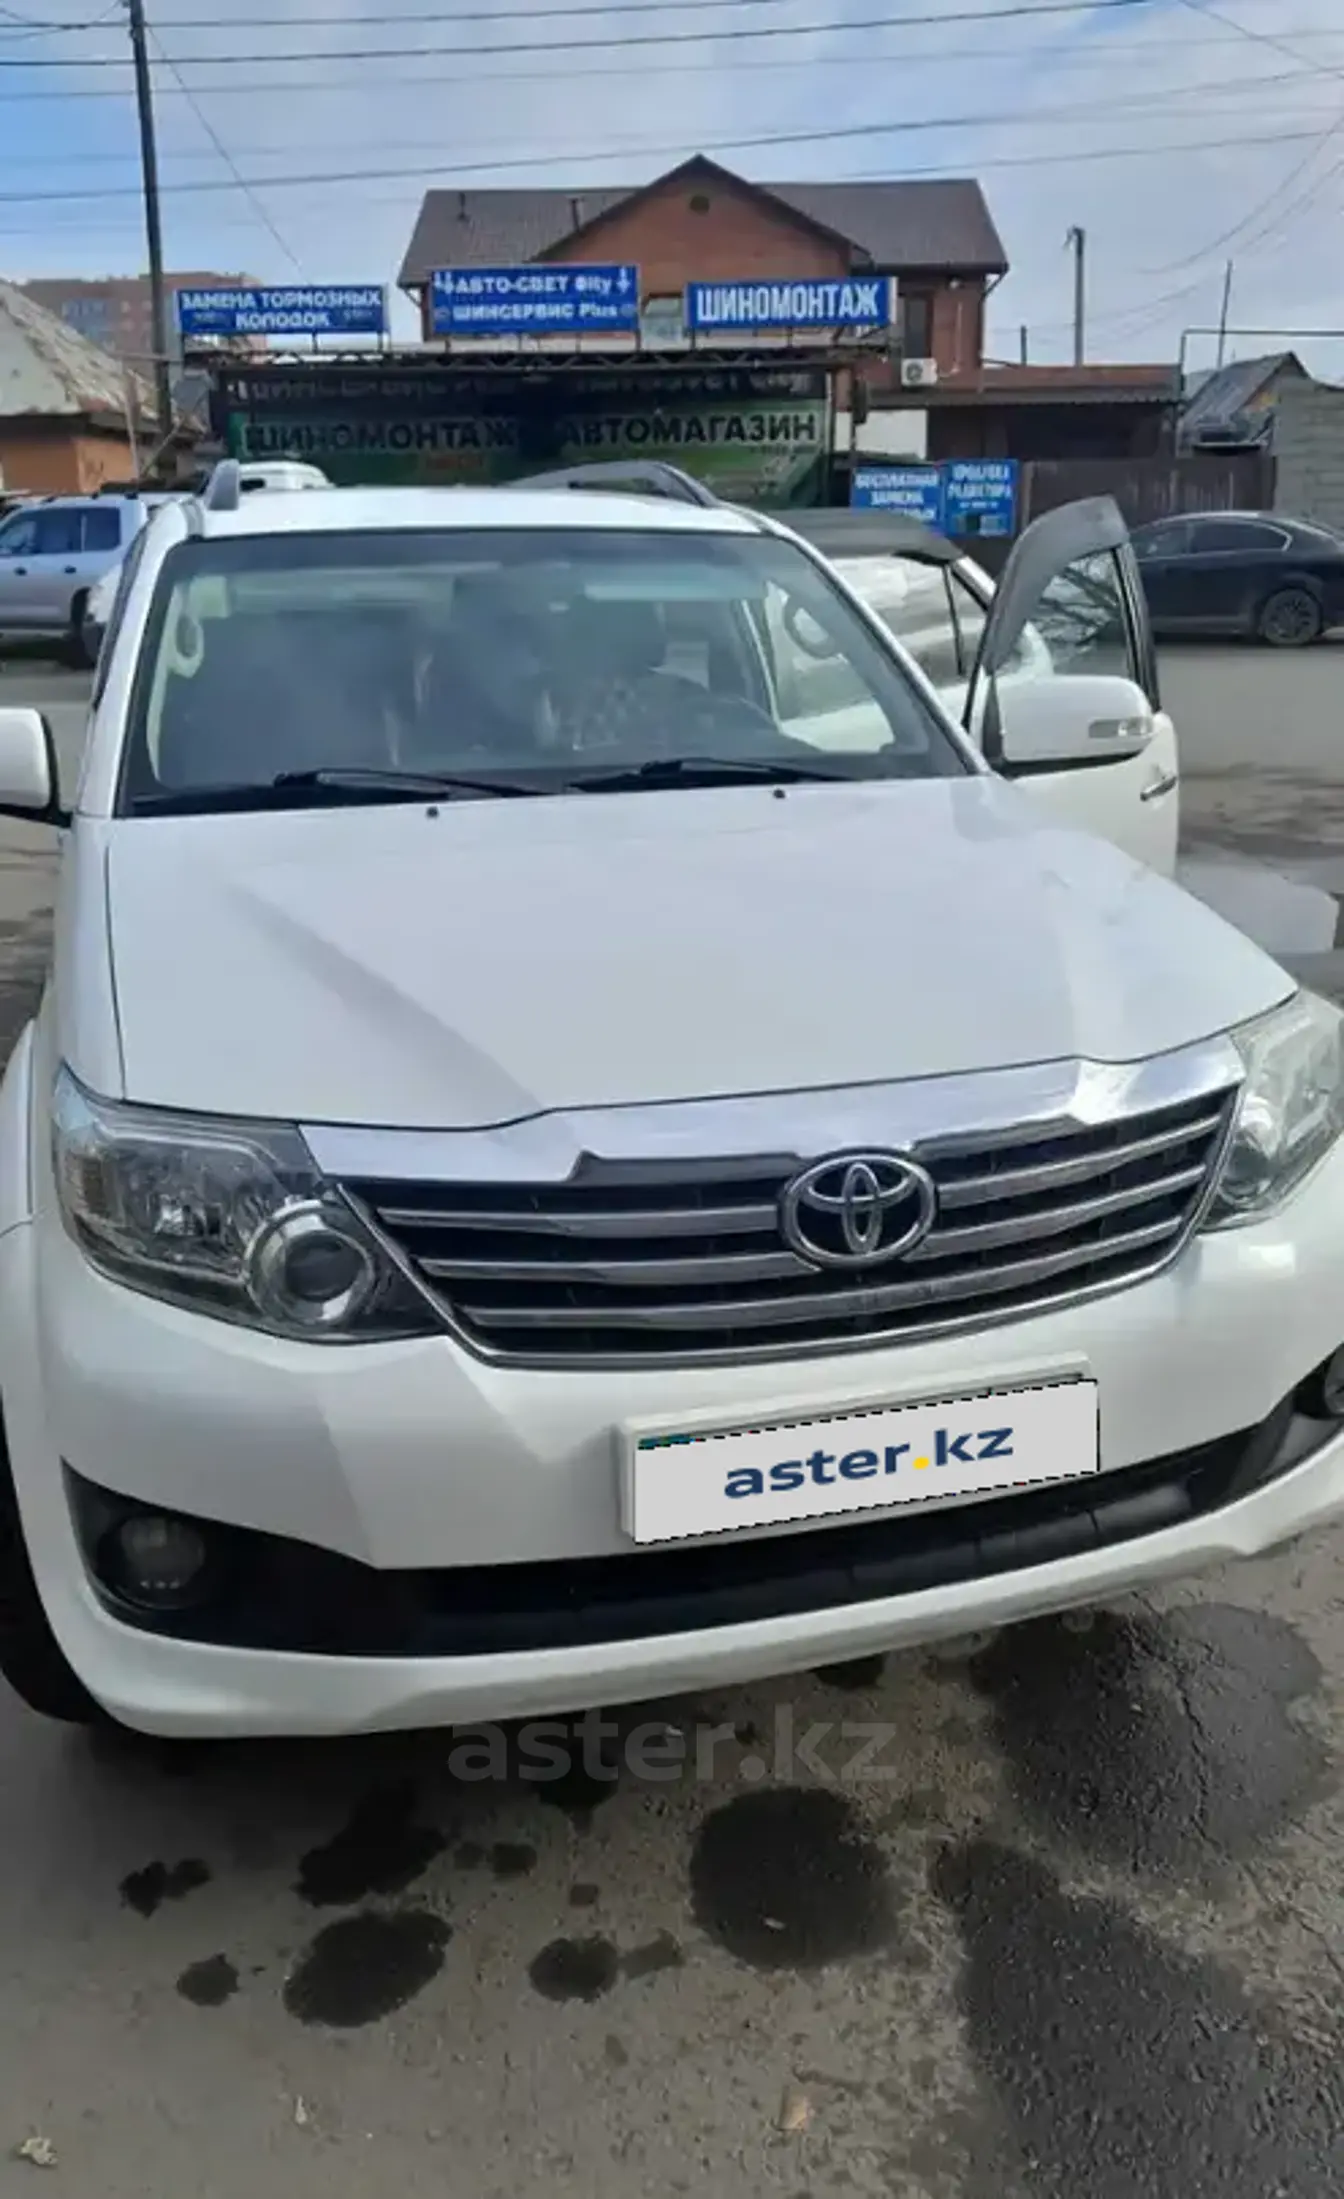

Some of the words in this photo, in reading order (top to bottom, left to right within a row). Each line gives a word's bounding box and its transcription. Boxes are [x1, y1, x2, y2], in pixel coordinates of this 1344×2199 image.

[181, 291, 257, 309] ЗАМЕНА
[260, 288, 381, 308] ТОРМОЗНЫХ
[453, 303, 574, 321] ШИНСЕРВИС
[696, 284, 881, 322] ШИНОМОНТАЖ
[245, 420, 517, 450] ШИНОМОНТАЖ
[563, 415, 816, 446] АВТОМАГАЗИН
